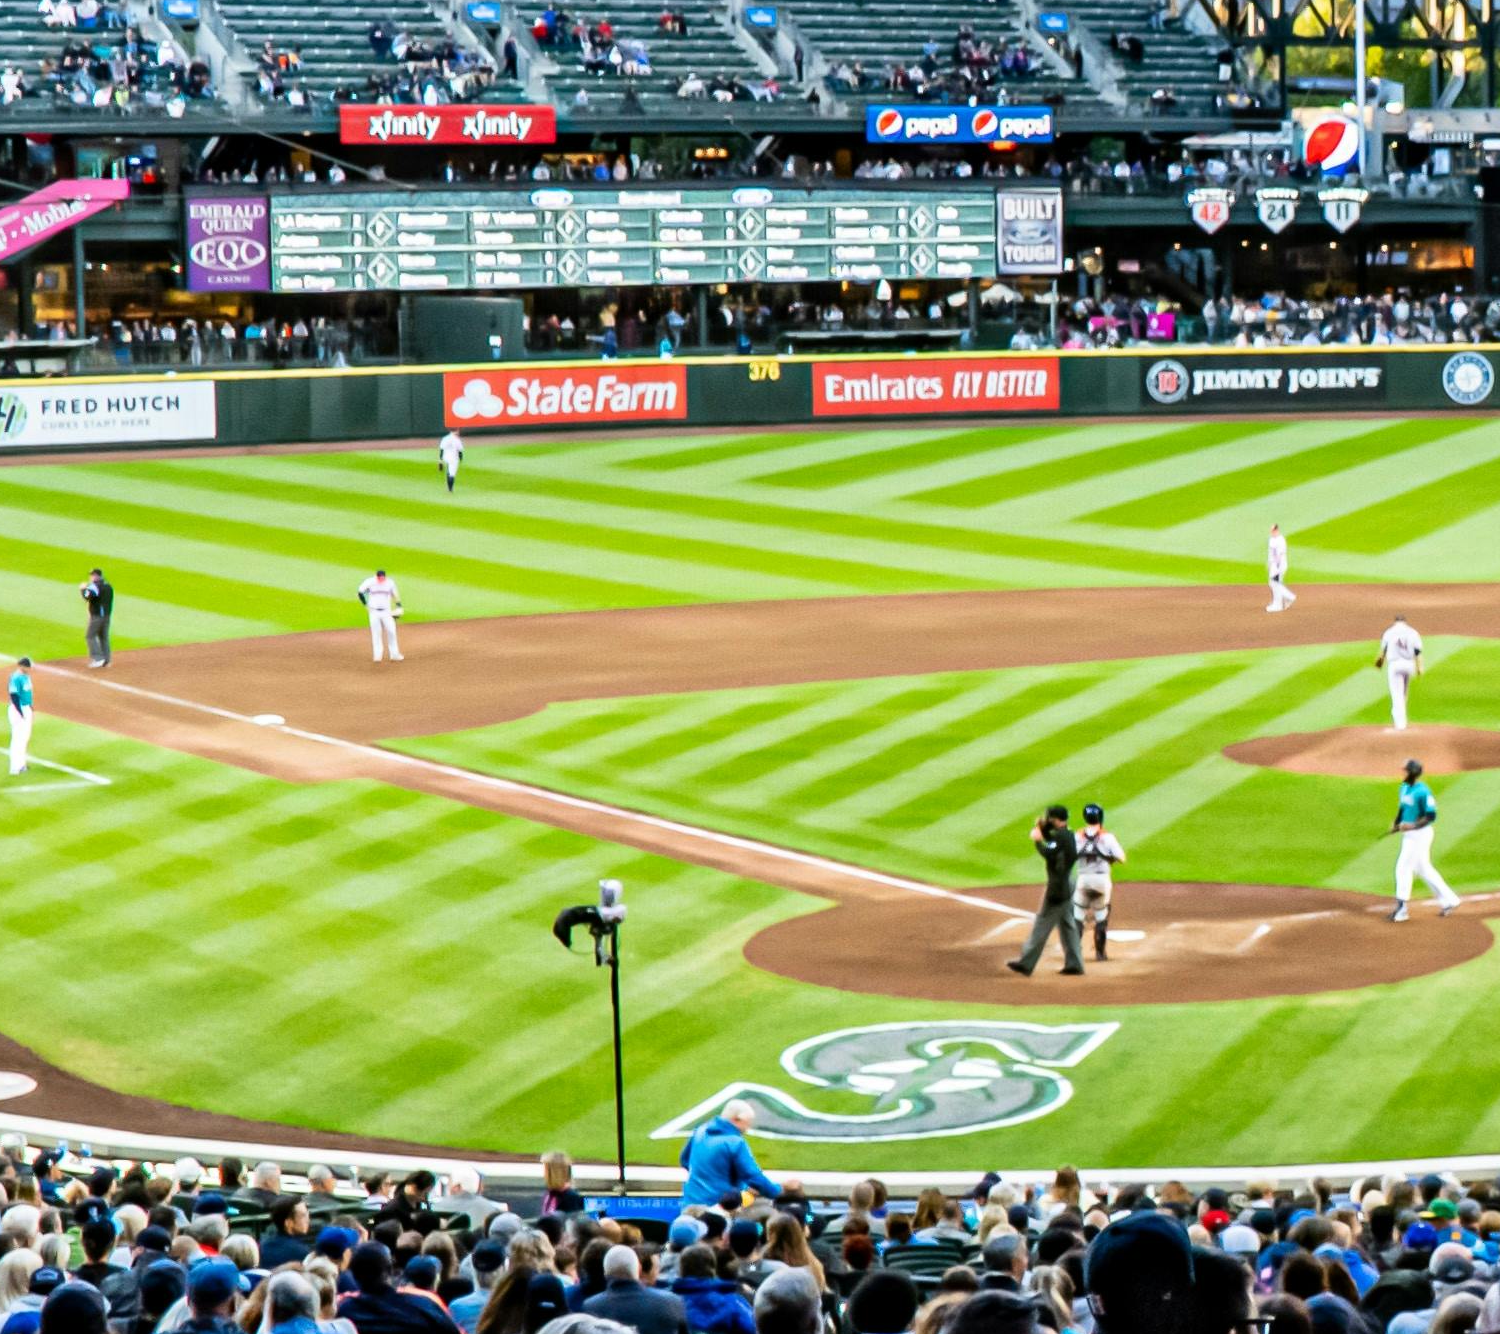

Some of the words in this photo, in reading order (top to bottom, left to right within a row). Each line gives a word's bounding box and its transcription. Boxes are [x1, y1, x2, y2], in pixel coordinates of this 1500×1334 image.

[368, 111, 441, 141] xfinity
[462, 111, 532, 141] xfinity
[905, 114, 957, 141] pepsi
[1000, 114, 1051, 141] pepsi
[190, 204, 266, 219] EMERALD
[1003, 198, 1055, 220] BUILT
[1200, 204, 1221, 221] 42
[1268, 204, 1286, 221] 24
[1336, 203, 1350, 221] 11
[202, 218, 253, 234] QUEEN
[1004, 245, 1056, 263] TOUGH
[825, 374, 942, 402] Emirates
[952, 371, 982, 399] FLY
[984, 370, 1048, 398] BETTER
[1192, 368, 1282, 395] JIMMY
[1289, 366, 1380, 392] JOHN'S
[41, 398, 97, 415] FRED
[107, 395, 180, 412] HUTCH
